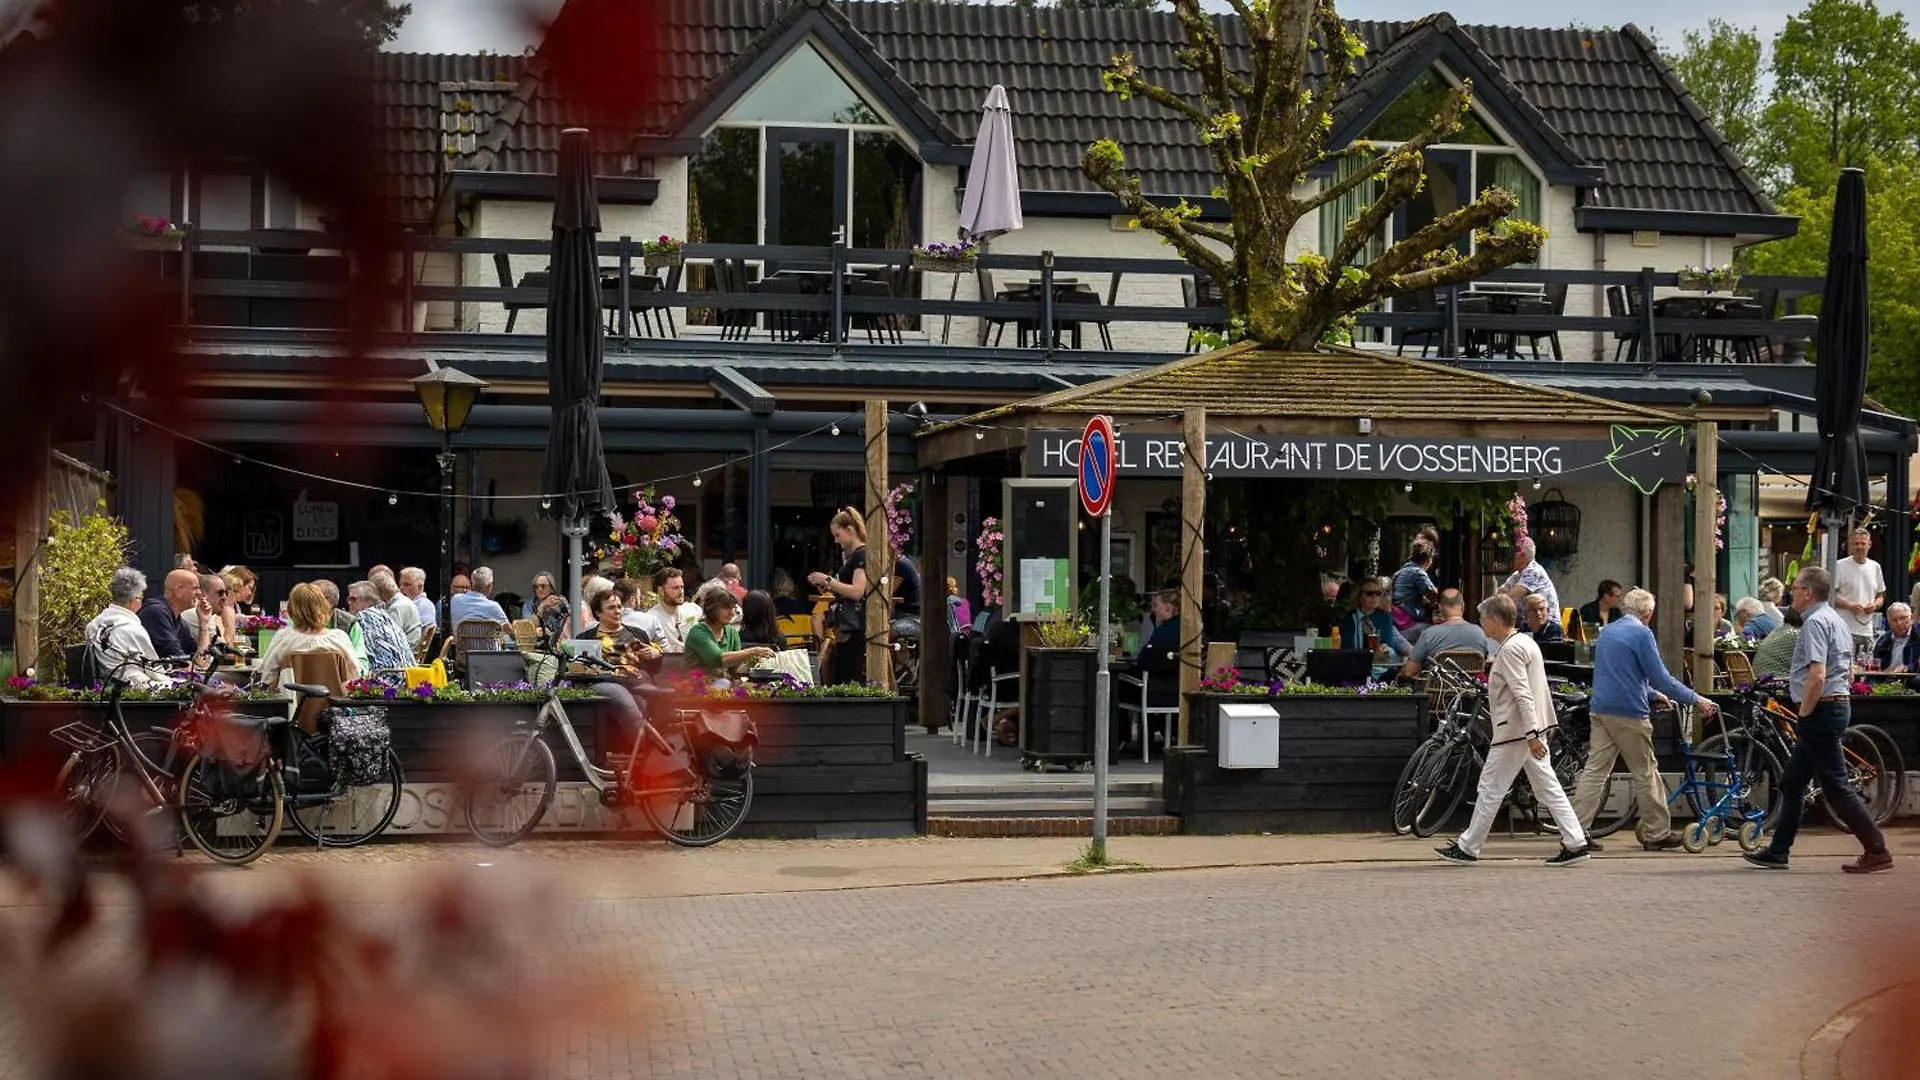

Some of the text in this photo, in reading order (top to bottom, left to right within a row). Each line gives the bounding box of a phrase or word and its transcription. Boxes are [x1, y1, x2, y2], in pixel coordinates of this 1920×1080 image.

[1043, 438, 1138, 468] HOEL
[1335, 443, 1372, 471] DE
[1379, 443, 1562, 474] VOSSENBERG
